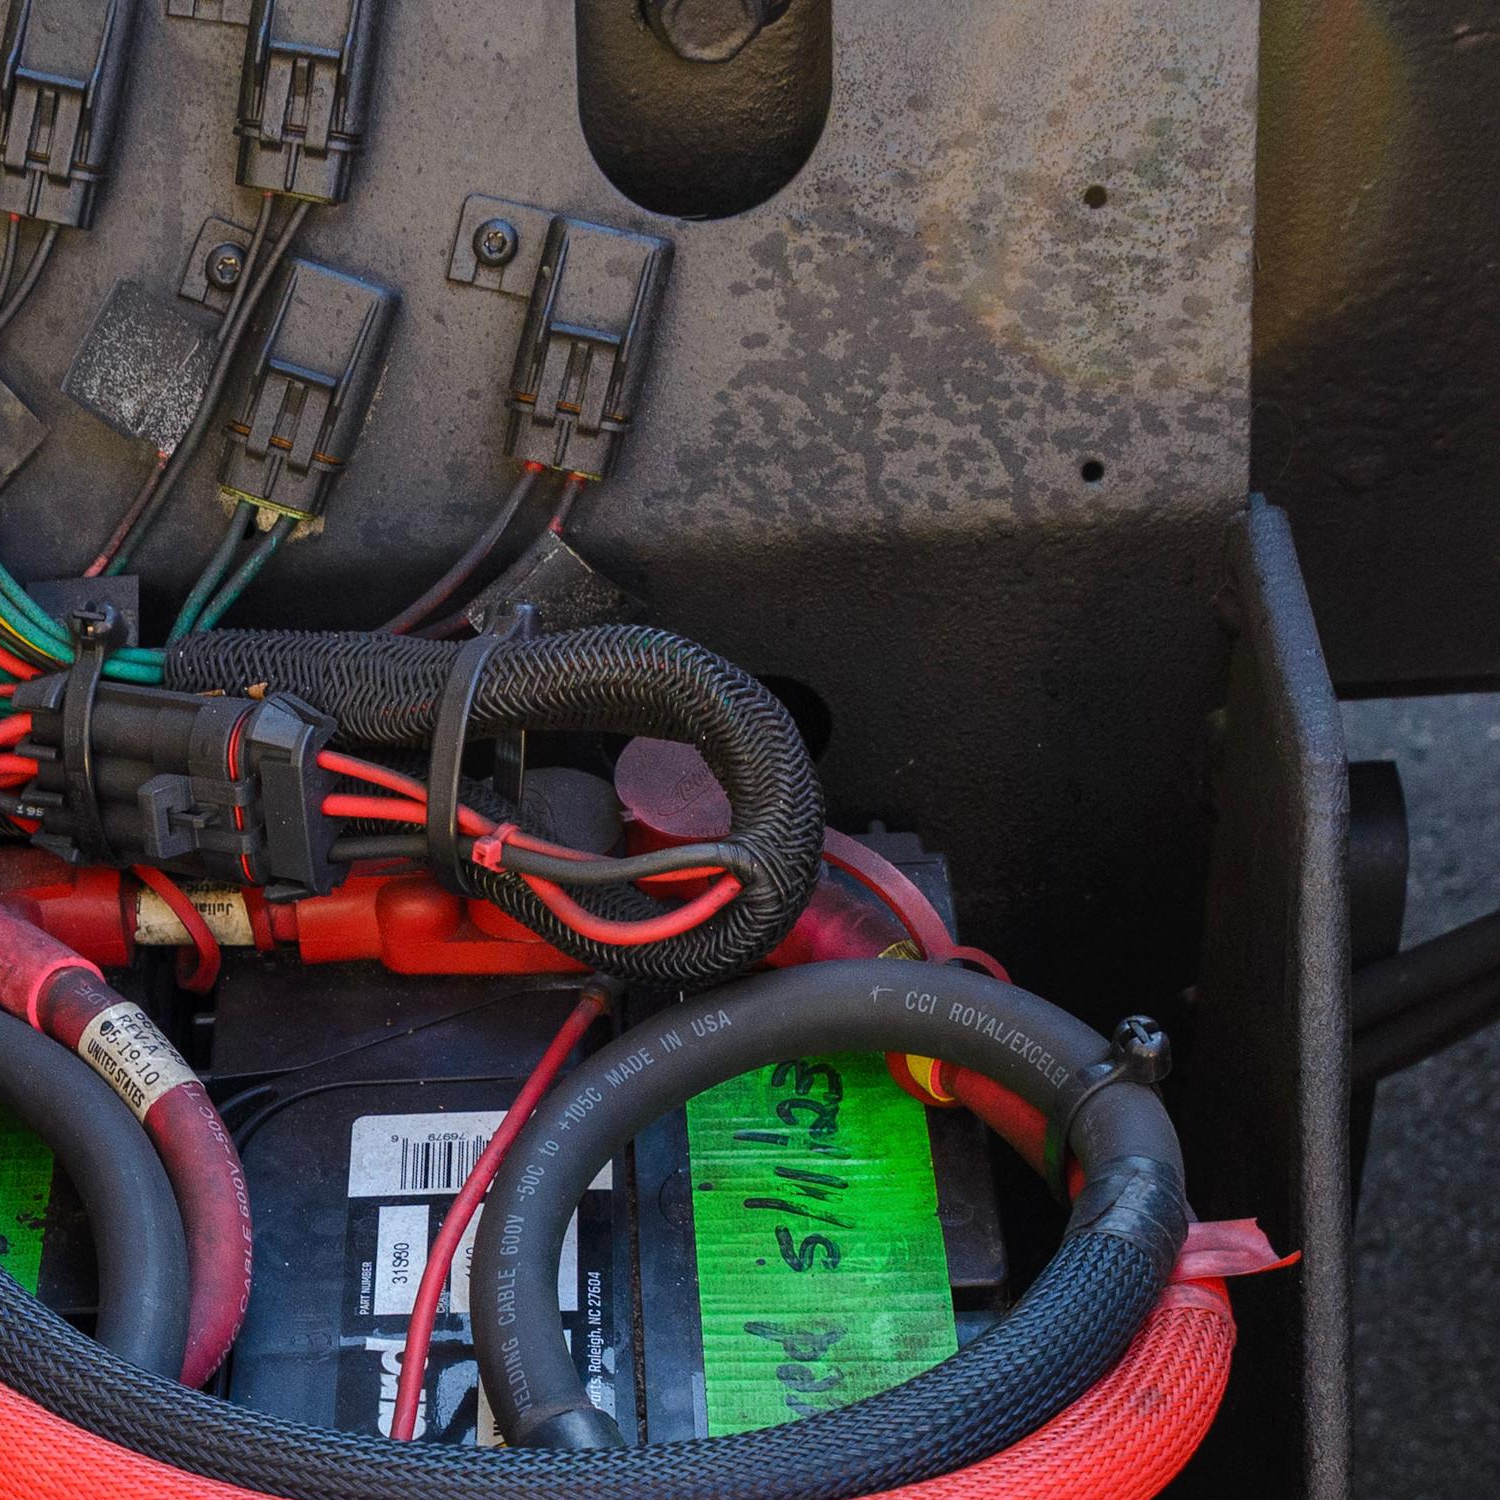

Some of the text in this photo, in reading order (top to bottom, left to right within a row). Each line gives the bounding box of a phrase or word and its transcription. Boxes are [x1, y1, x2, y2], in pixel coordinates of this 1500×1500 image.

[691, 1008, 733, 1038] USA
[904, 990, 938, 1015] CCI
[659, 1029, 685, 1053] IN
[87, 1038, 146, 1109] UNITED STATES
[605, 1047, 655, 1089] MADE
[558, 1086, 603, 1133] +105C
[428, 1132, 467, 1143] 76979
[541, 1139, 560, 1159] to
[225, 1159, 252, 1218] 600V
[519, 1163, 546, 1205] -50C
[500, 1213, 526, 1262] 600V
[238, 1224, 254, 1314] CABLE
[359, 1261, 373, 1316] PART NUMBER
[587, 1271, 601, 1304] 27604
[498, 1267, 517, 1328] CABLE
[588, 1305, 601, 1325] NC
[587, 1326, 603, 1373] Raleigh,
